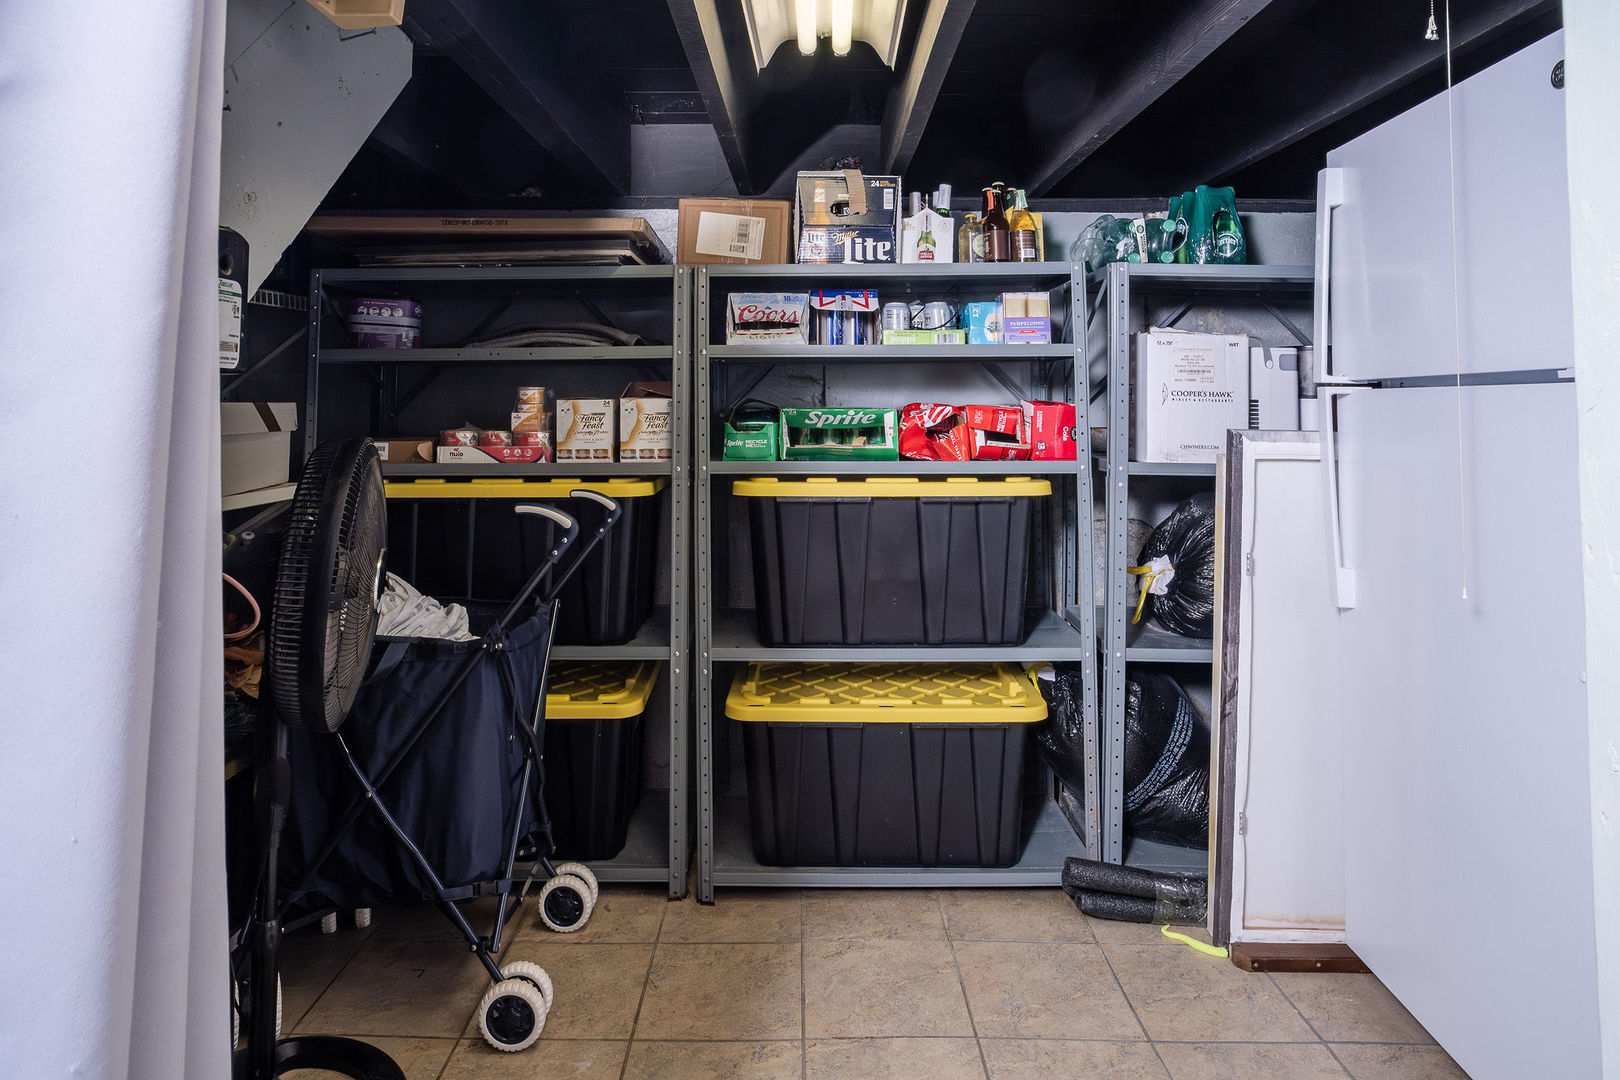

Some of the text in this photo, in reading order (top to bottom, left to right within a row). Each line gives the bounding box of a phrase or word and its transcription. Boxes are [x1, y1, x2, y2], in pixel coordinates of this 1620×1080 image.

[832, 230, 860, 246] Miller
[842, 238, 891, 264] Lite
[738, 304, 798, 323] Coors
[578, 413, 605, 422] Fancy
[642, 413, 670, 422] Fancy
[805, 410, 876, 428] Sprite
[582, 422, 604, 430] Feast
[646, 422, 670, 430] Feast
[727, 439, 743, 447] Sprite
[954, 445, 962, 460] TASTE
